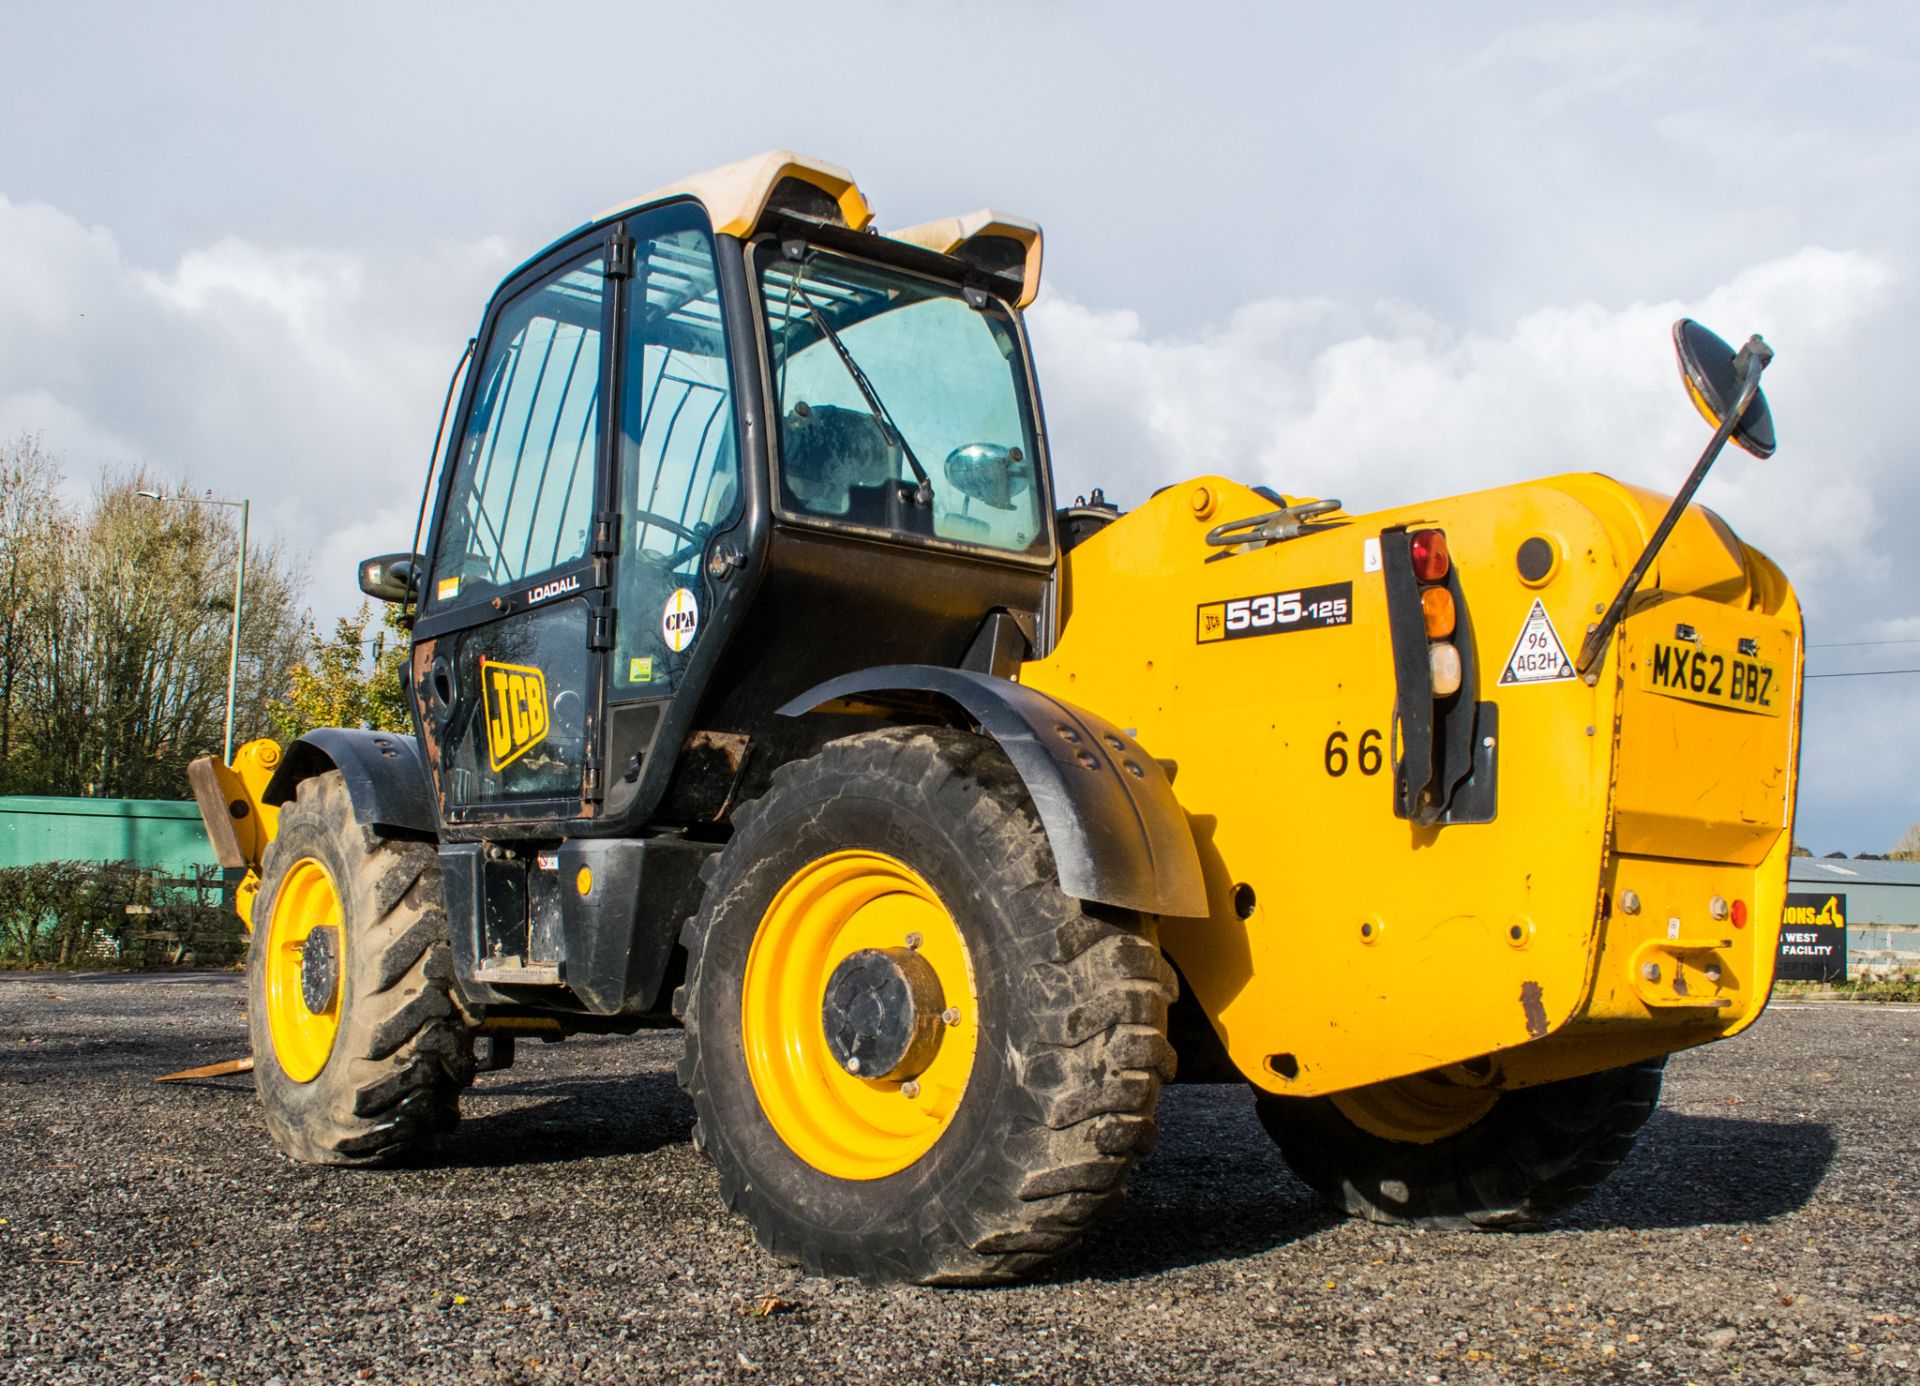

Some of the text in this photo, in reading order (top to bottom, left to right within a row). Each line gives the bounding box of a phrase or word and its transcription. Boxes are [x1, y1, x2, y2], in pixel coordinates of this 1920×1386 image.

[528, 576, 580, 604] LOADALL
[665, 611, 695, 630] CPA
[1206, 615, 1221, 631] JCB
[1528, 632, 1547, 650] 96
[1517, 652, 1557, 672] AG2H
[1652, 643, 1773, 706] MX62 BBZ
[491, 672, 545, 758] JCB
[1324, 729, 1383, 777] 66
[1785, 933, 1818, 943] WEST
[1782, 945, 1832, 955] FACILITY
